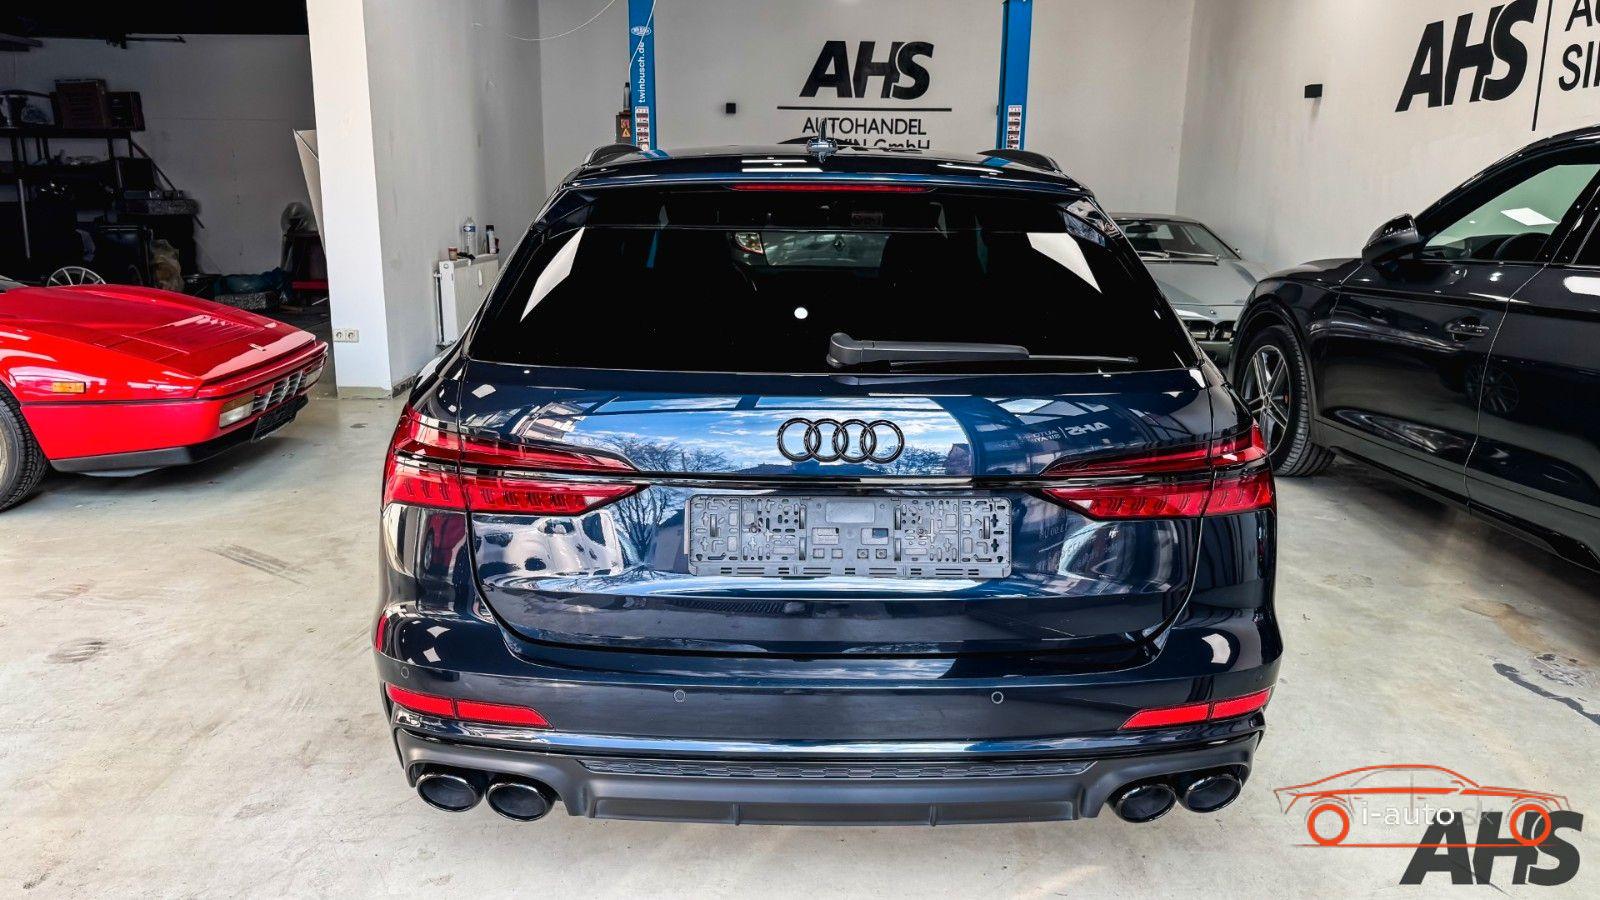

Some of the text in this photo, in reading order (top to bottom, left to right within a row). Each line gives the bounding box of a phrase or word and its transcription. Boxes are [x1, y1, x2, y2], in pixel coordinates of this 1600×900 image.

[1564, 0, 1600, 32] A
[638, 42, 646, 103] twinbusch.de
[799, 40, 935, 100] AHS
[1395, 0, 1538, 112] AHS
[1558, 41, 1600, 91] SI
[802, 117, 927, 135] AUTOHANDEL
